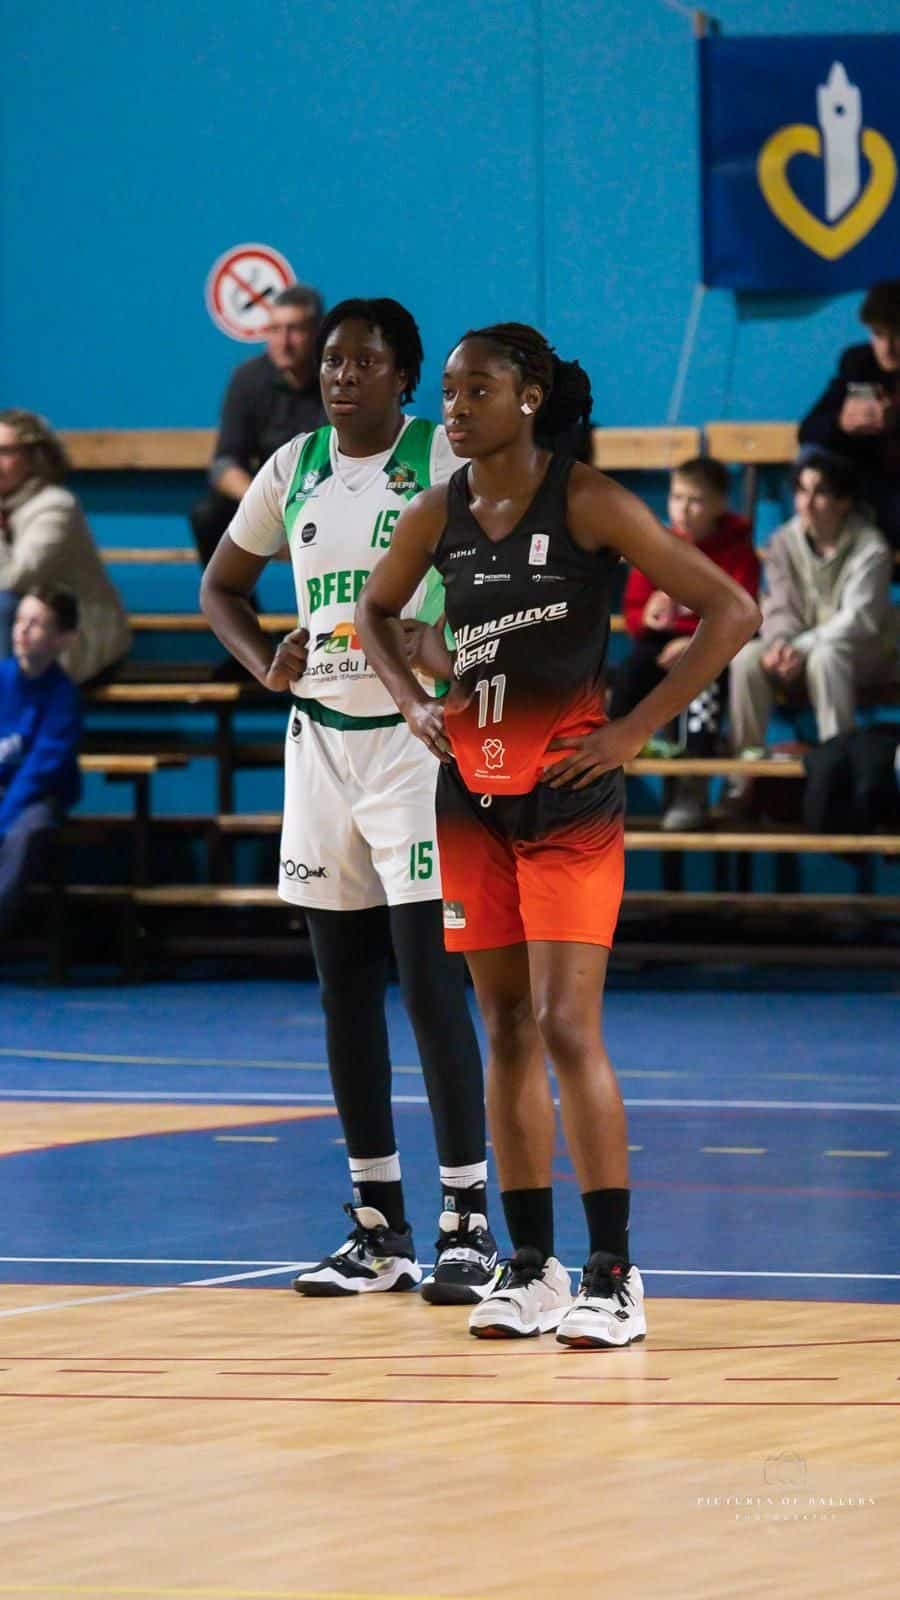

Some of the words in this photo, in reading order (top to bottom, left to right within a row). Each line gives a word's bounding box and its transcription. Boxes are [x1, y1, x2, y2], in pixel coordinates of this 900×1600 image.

[371, 510, 400, 549] 15
[307, 570, 370, 614] BFEP
[454, 602, 569, 652] illeneuve
[339, 658, 359, 673] du
[475, 674, 507, 729] 11
[410, 841, 433, 881] 15
